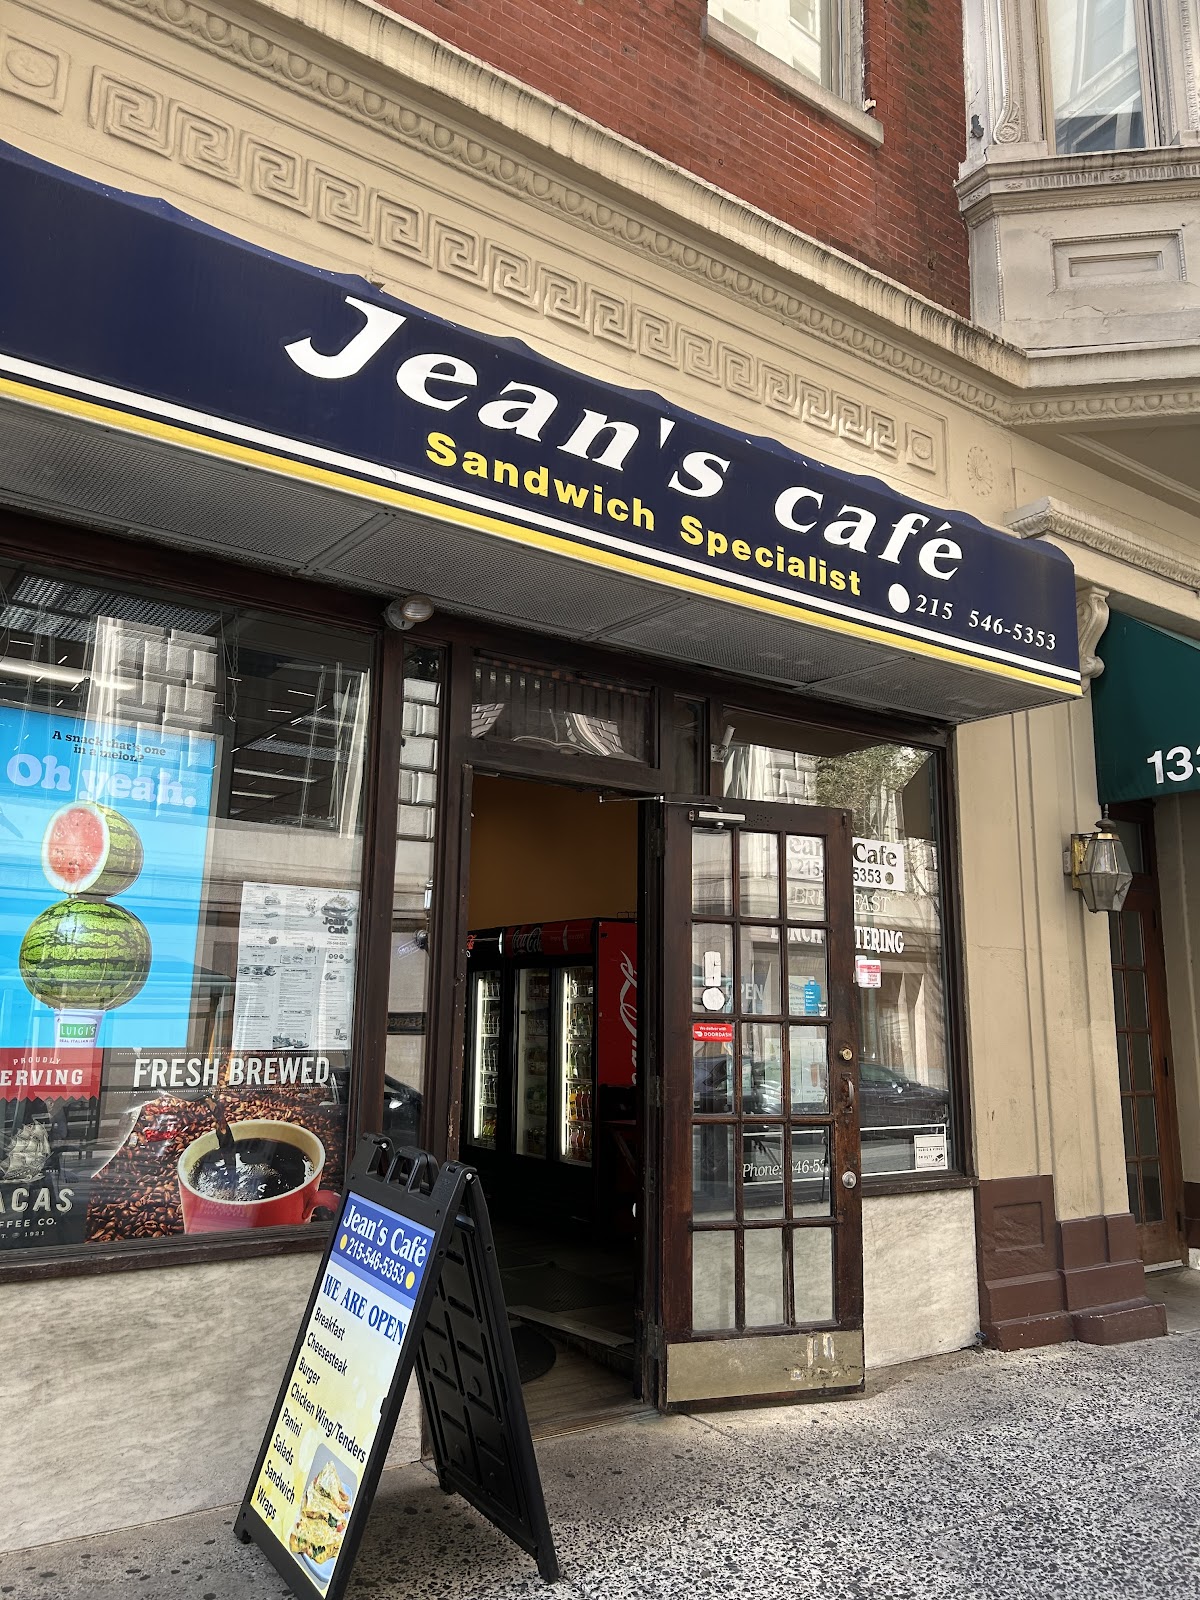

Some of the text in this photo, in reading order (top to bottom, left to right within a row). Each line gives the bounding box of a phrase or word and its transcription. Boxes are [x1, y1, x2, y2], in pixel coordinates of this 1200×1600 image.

[284, 295, 963, 581] Jean's café
[425, 431, 861, 597] Sandwich Specialist
[915, 594, 1057, 651] 215 546-5353
[52, 730, 62, 741] A
[65, 733, 103, 746] snack
[144, 746, 166, 756] one
[73, 744, 86, 755] in
[89, 748, 97, 756] a
[6, 753, 196, 808] Oh yeah.
[1147, 746, 1200, 785] 13
[853, 842, 898, 867] Cafe
[855, 926, 905, 954] TERING
[61, 1025, 96, 1037] LUIGI'S
[0, 1068, 83, 1087] ERVING
[13, 1056, 61, 1065] PROUDLY
[133, 1056, 331, 1089] FRESH BREWED
[343, 1205, 428, 1267] Jean's Café
[346, 1237, 406, 1285] 215-546-5353
[314, 1307, 346, 1341] Breakfast
[322, 1273, 407, 1346] WE ARE OPEN
[298, 1356, 321, 1386] Burger
[307, 1332, 348, 1376] Cheesesteak
[281, 1407, 303, 1438] Panini
[290, 1382, 367, 1464] Chicken Wing/Tenders
[273, 1433, 294, 1466] Salads
[264, 1459, 295, 1505] Sandwich
[256, 1485, 277, 1520] Wraps
